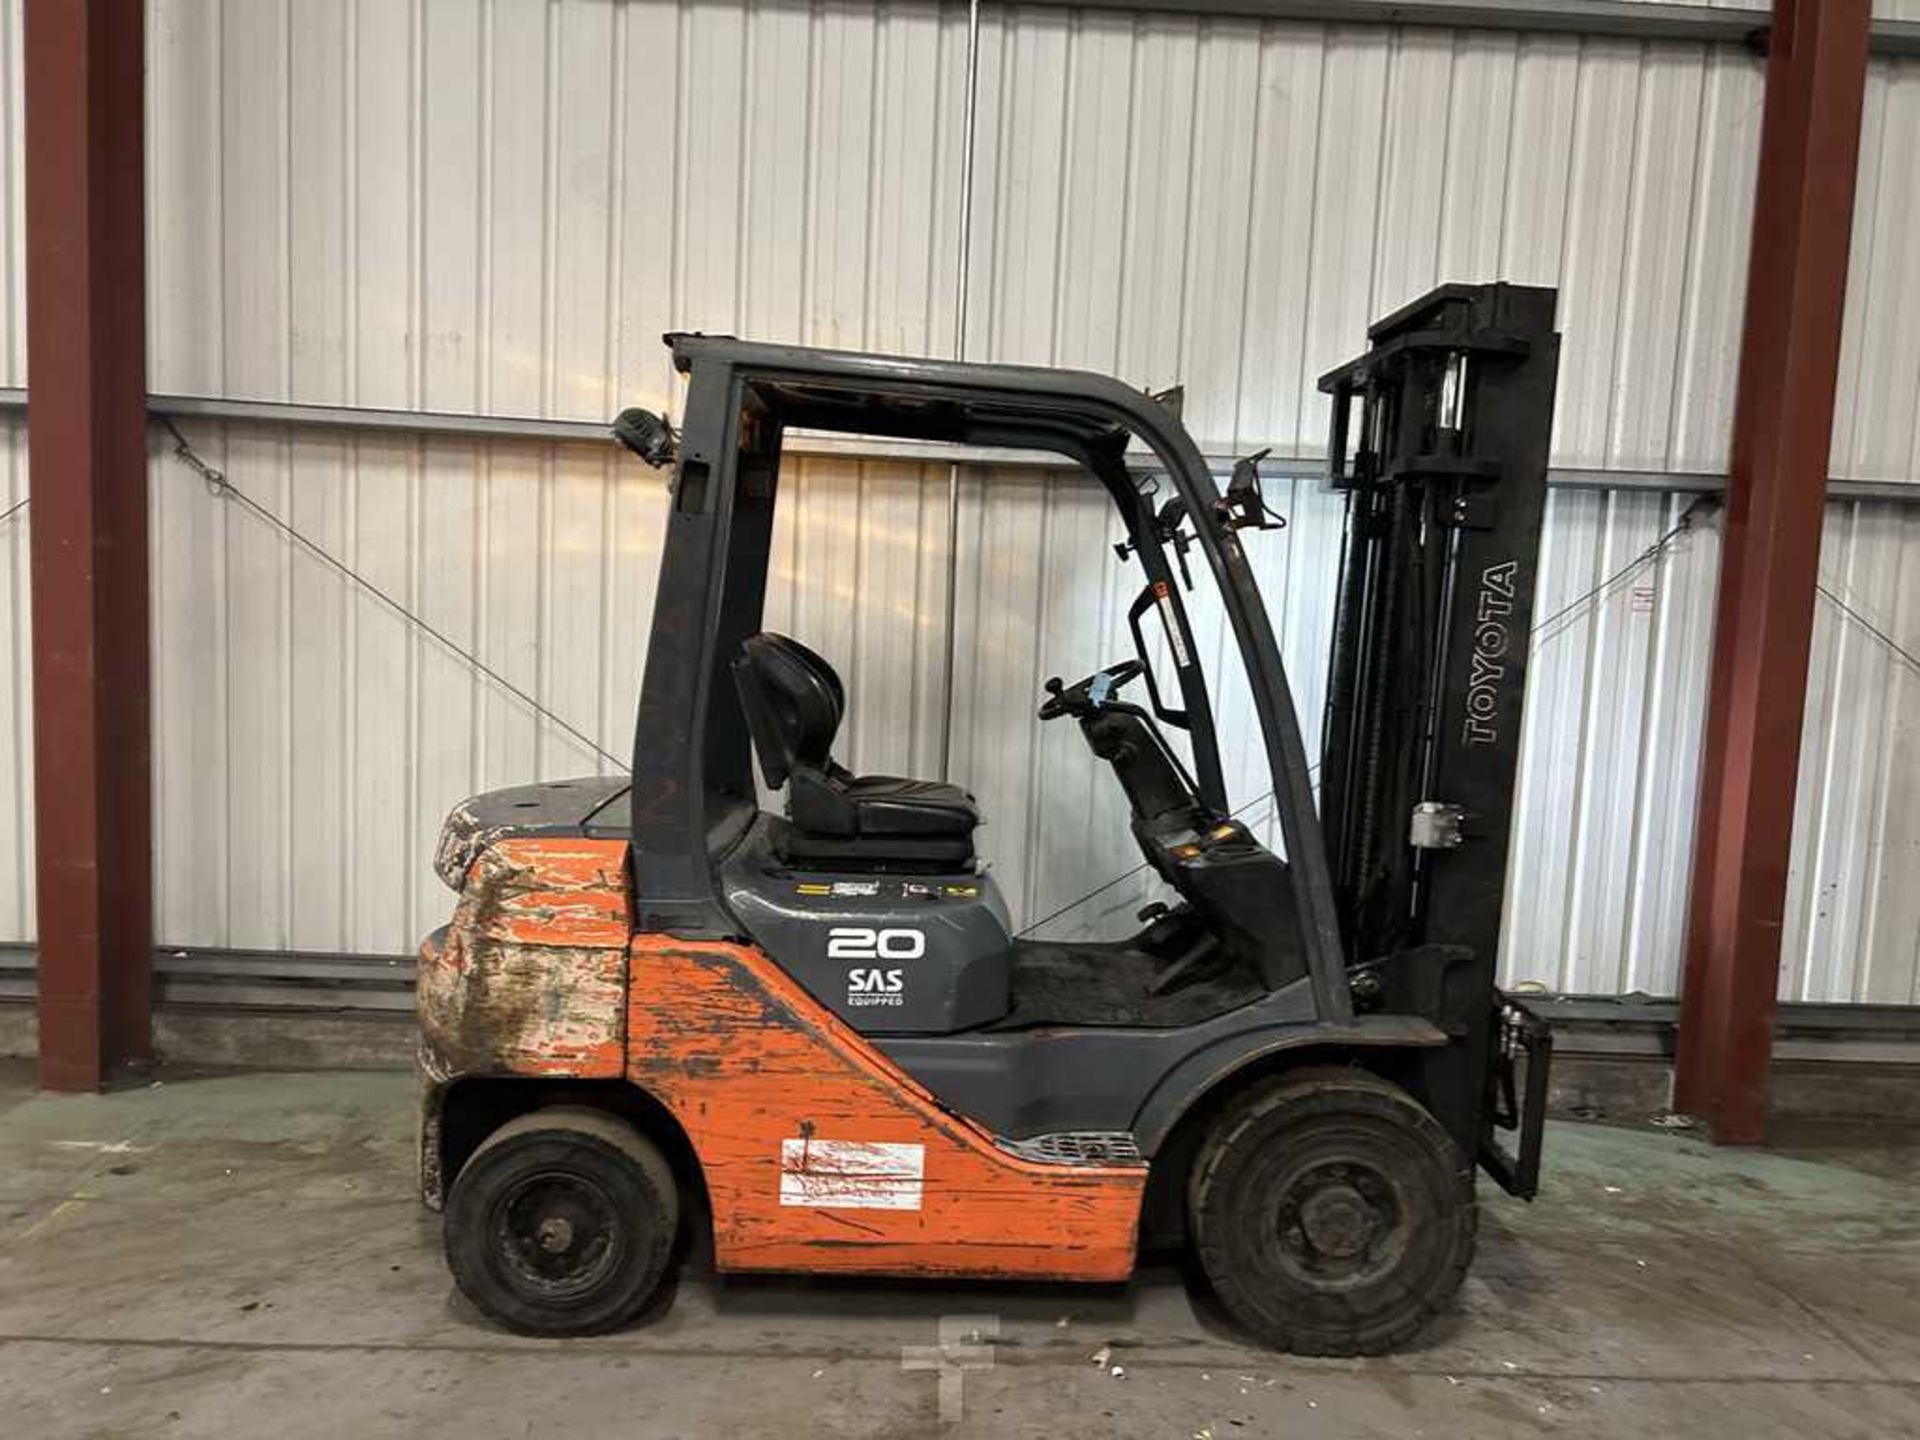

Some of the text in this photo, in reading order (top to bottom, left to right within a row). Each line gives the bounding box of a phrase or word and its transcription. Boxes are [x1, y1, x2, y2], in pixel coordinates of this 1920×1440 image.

[1461, 560, 1518, 747] TOYOTA
[827, 927, 925, 959] 20
[848, 968, 903, 991] SAS
